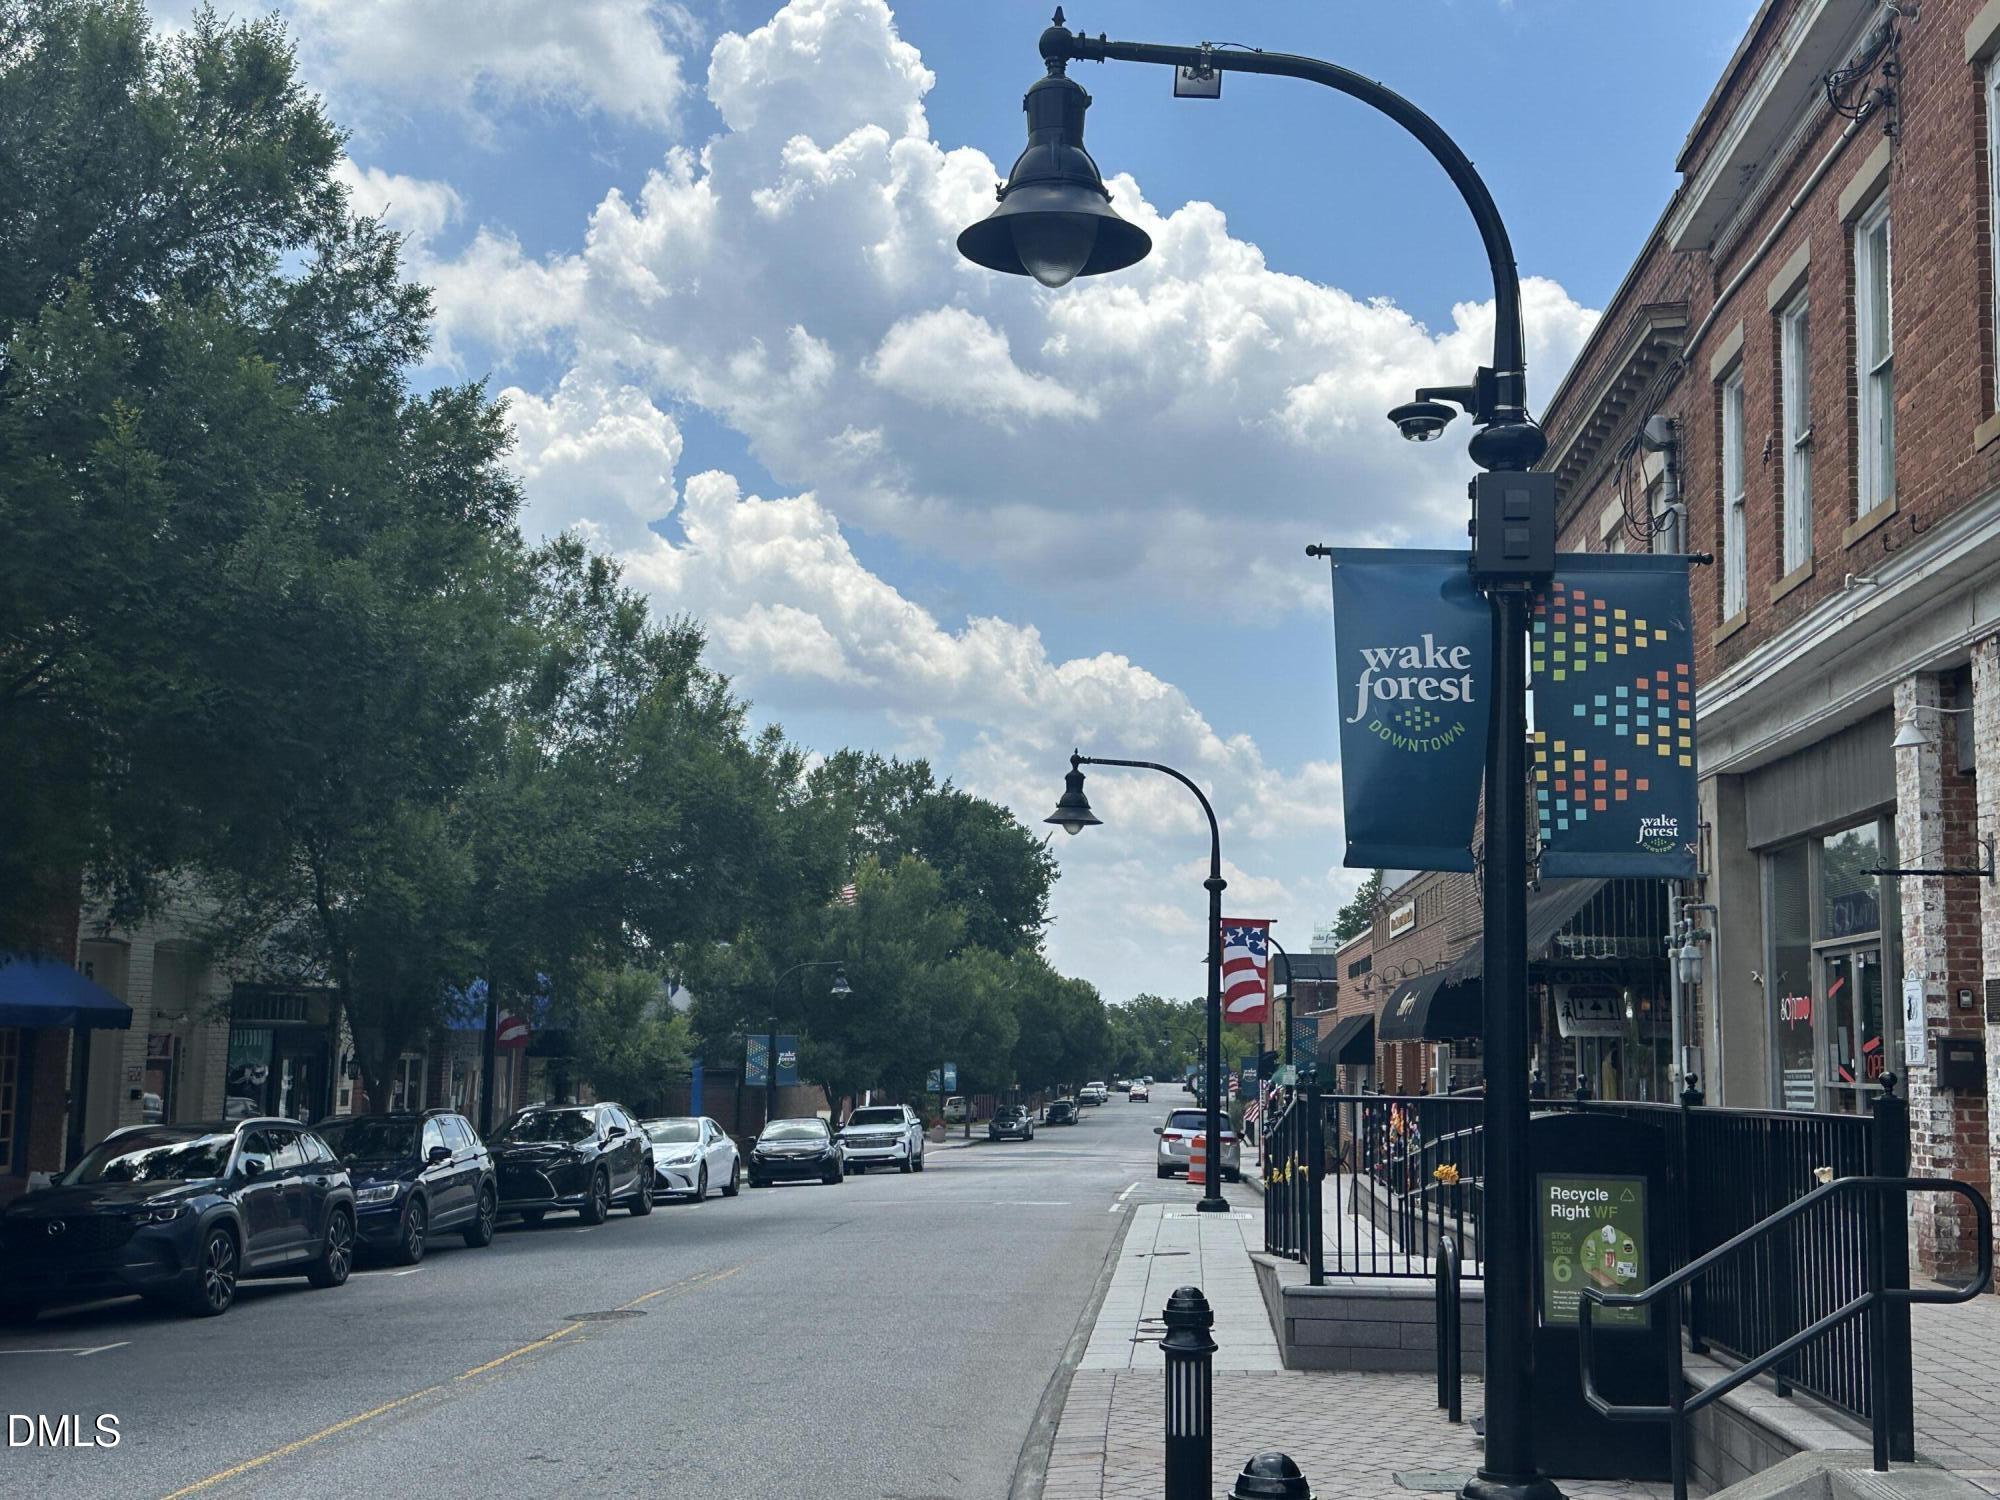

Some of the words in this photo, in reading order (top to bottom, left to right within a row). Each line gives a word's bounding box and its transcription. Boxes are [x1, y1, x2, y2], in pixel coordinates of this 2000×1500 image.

[1359, 633, 1472, 670] wake
[1346, 667, 1475, 724] forest
[1368, 719, 1466, 752] DOWNTOWN
[1641, 814, 1678, 827] wake
[1636, 825, 1679, 844] forest
[1550, 1186, 1609, 1203] Recycle
[1551, 1204, 1591, 1221] Right
[1594, 1206, 1618, 1219] WF
[1552, 1255, 1572, 1283] 6
